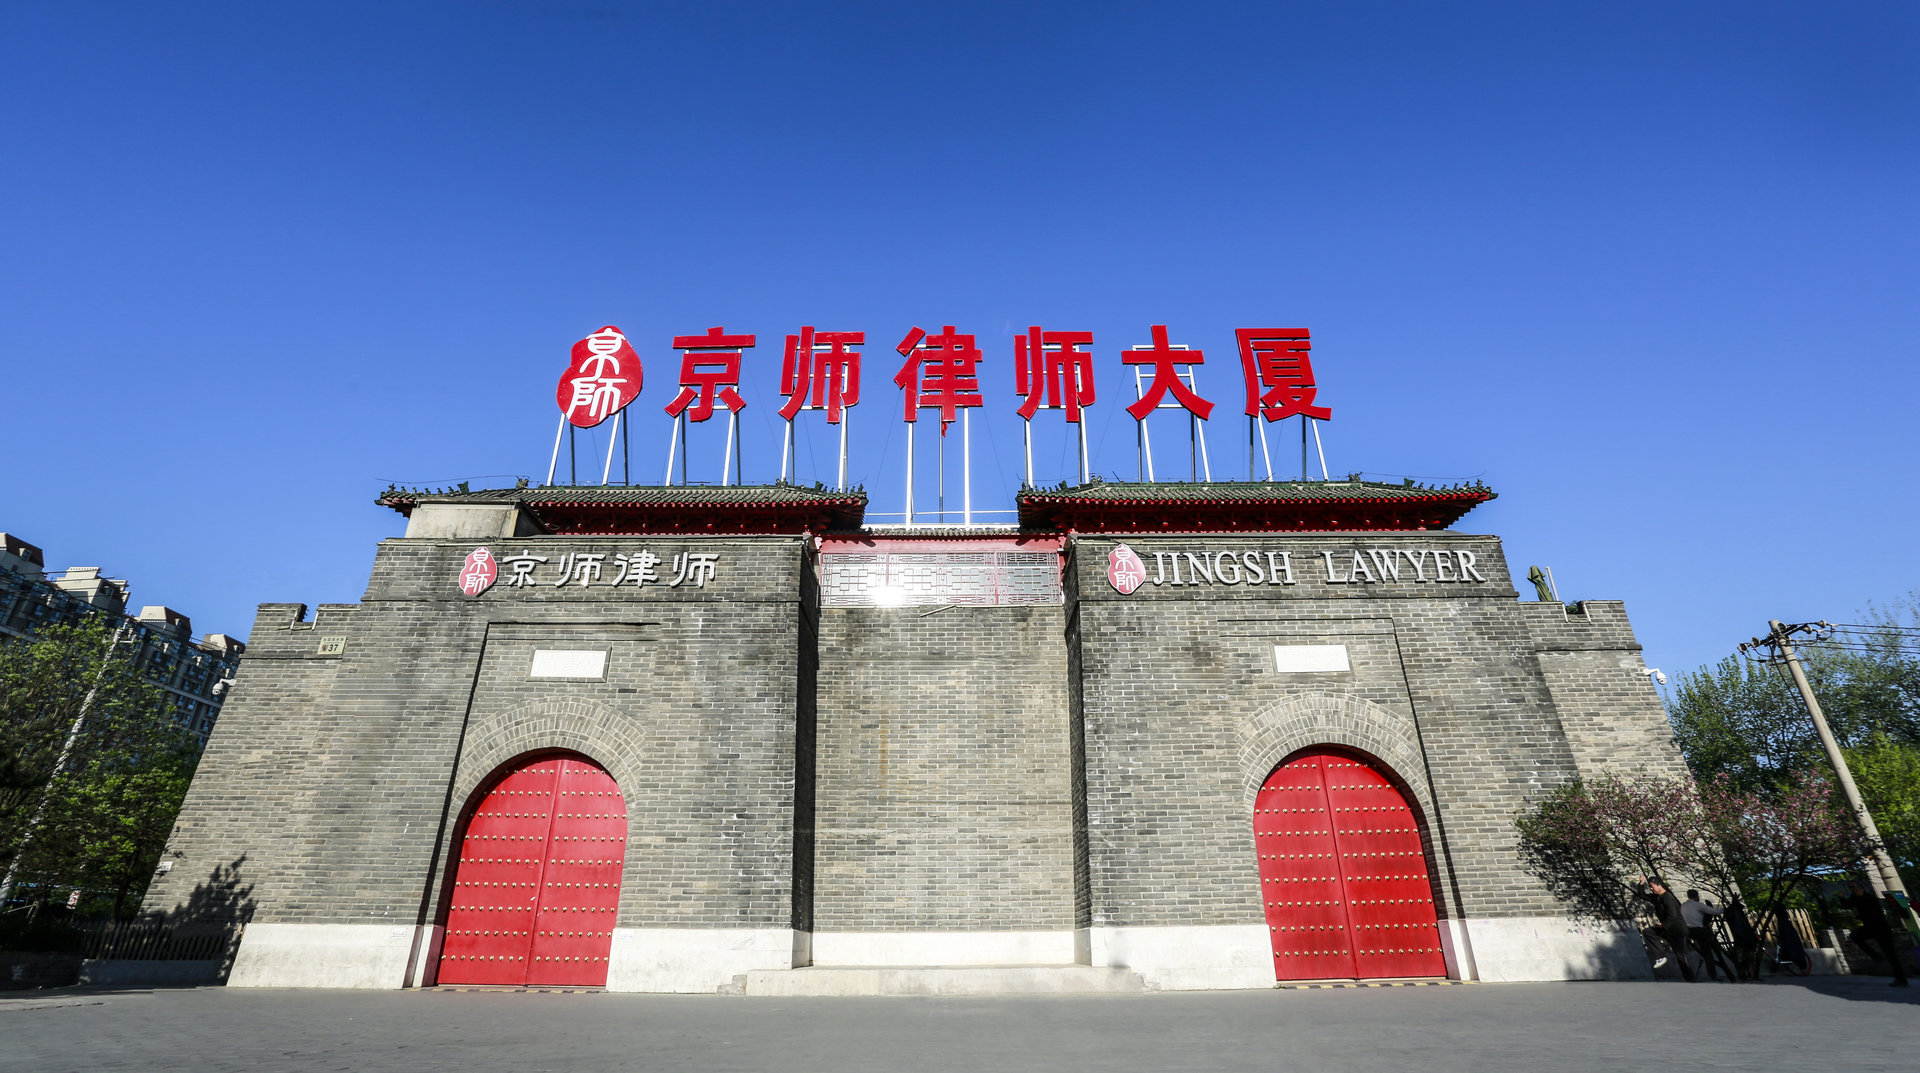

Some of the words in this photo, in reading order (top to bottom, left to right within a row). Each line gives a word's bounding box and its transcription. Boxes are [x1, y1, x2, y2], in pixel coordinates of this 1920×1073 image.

[665, 325, 1332, 423] 京师律师大厦
[1152, 550, 1296, 586] JINGSH
[1321, 549, 1486, 583] LAWYER
[328, 643, 339, 651] 37
